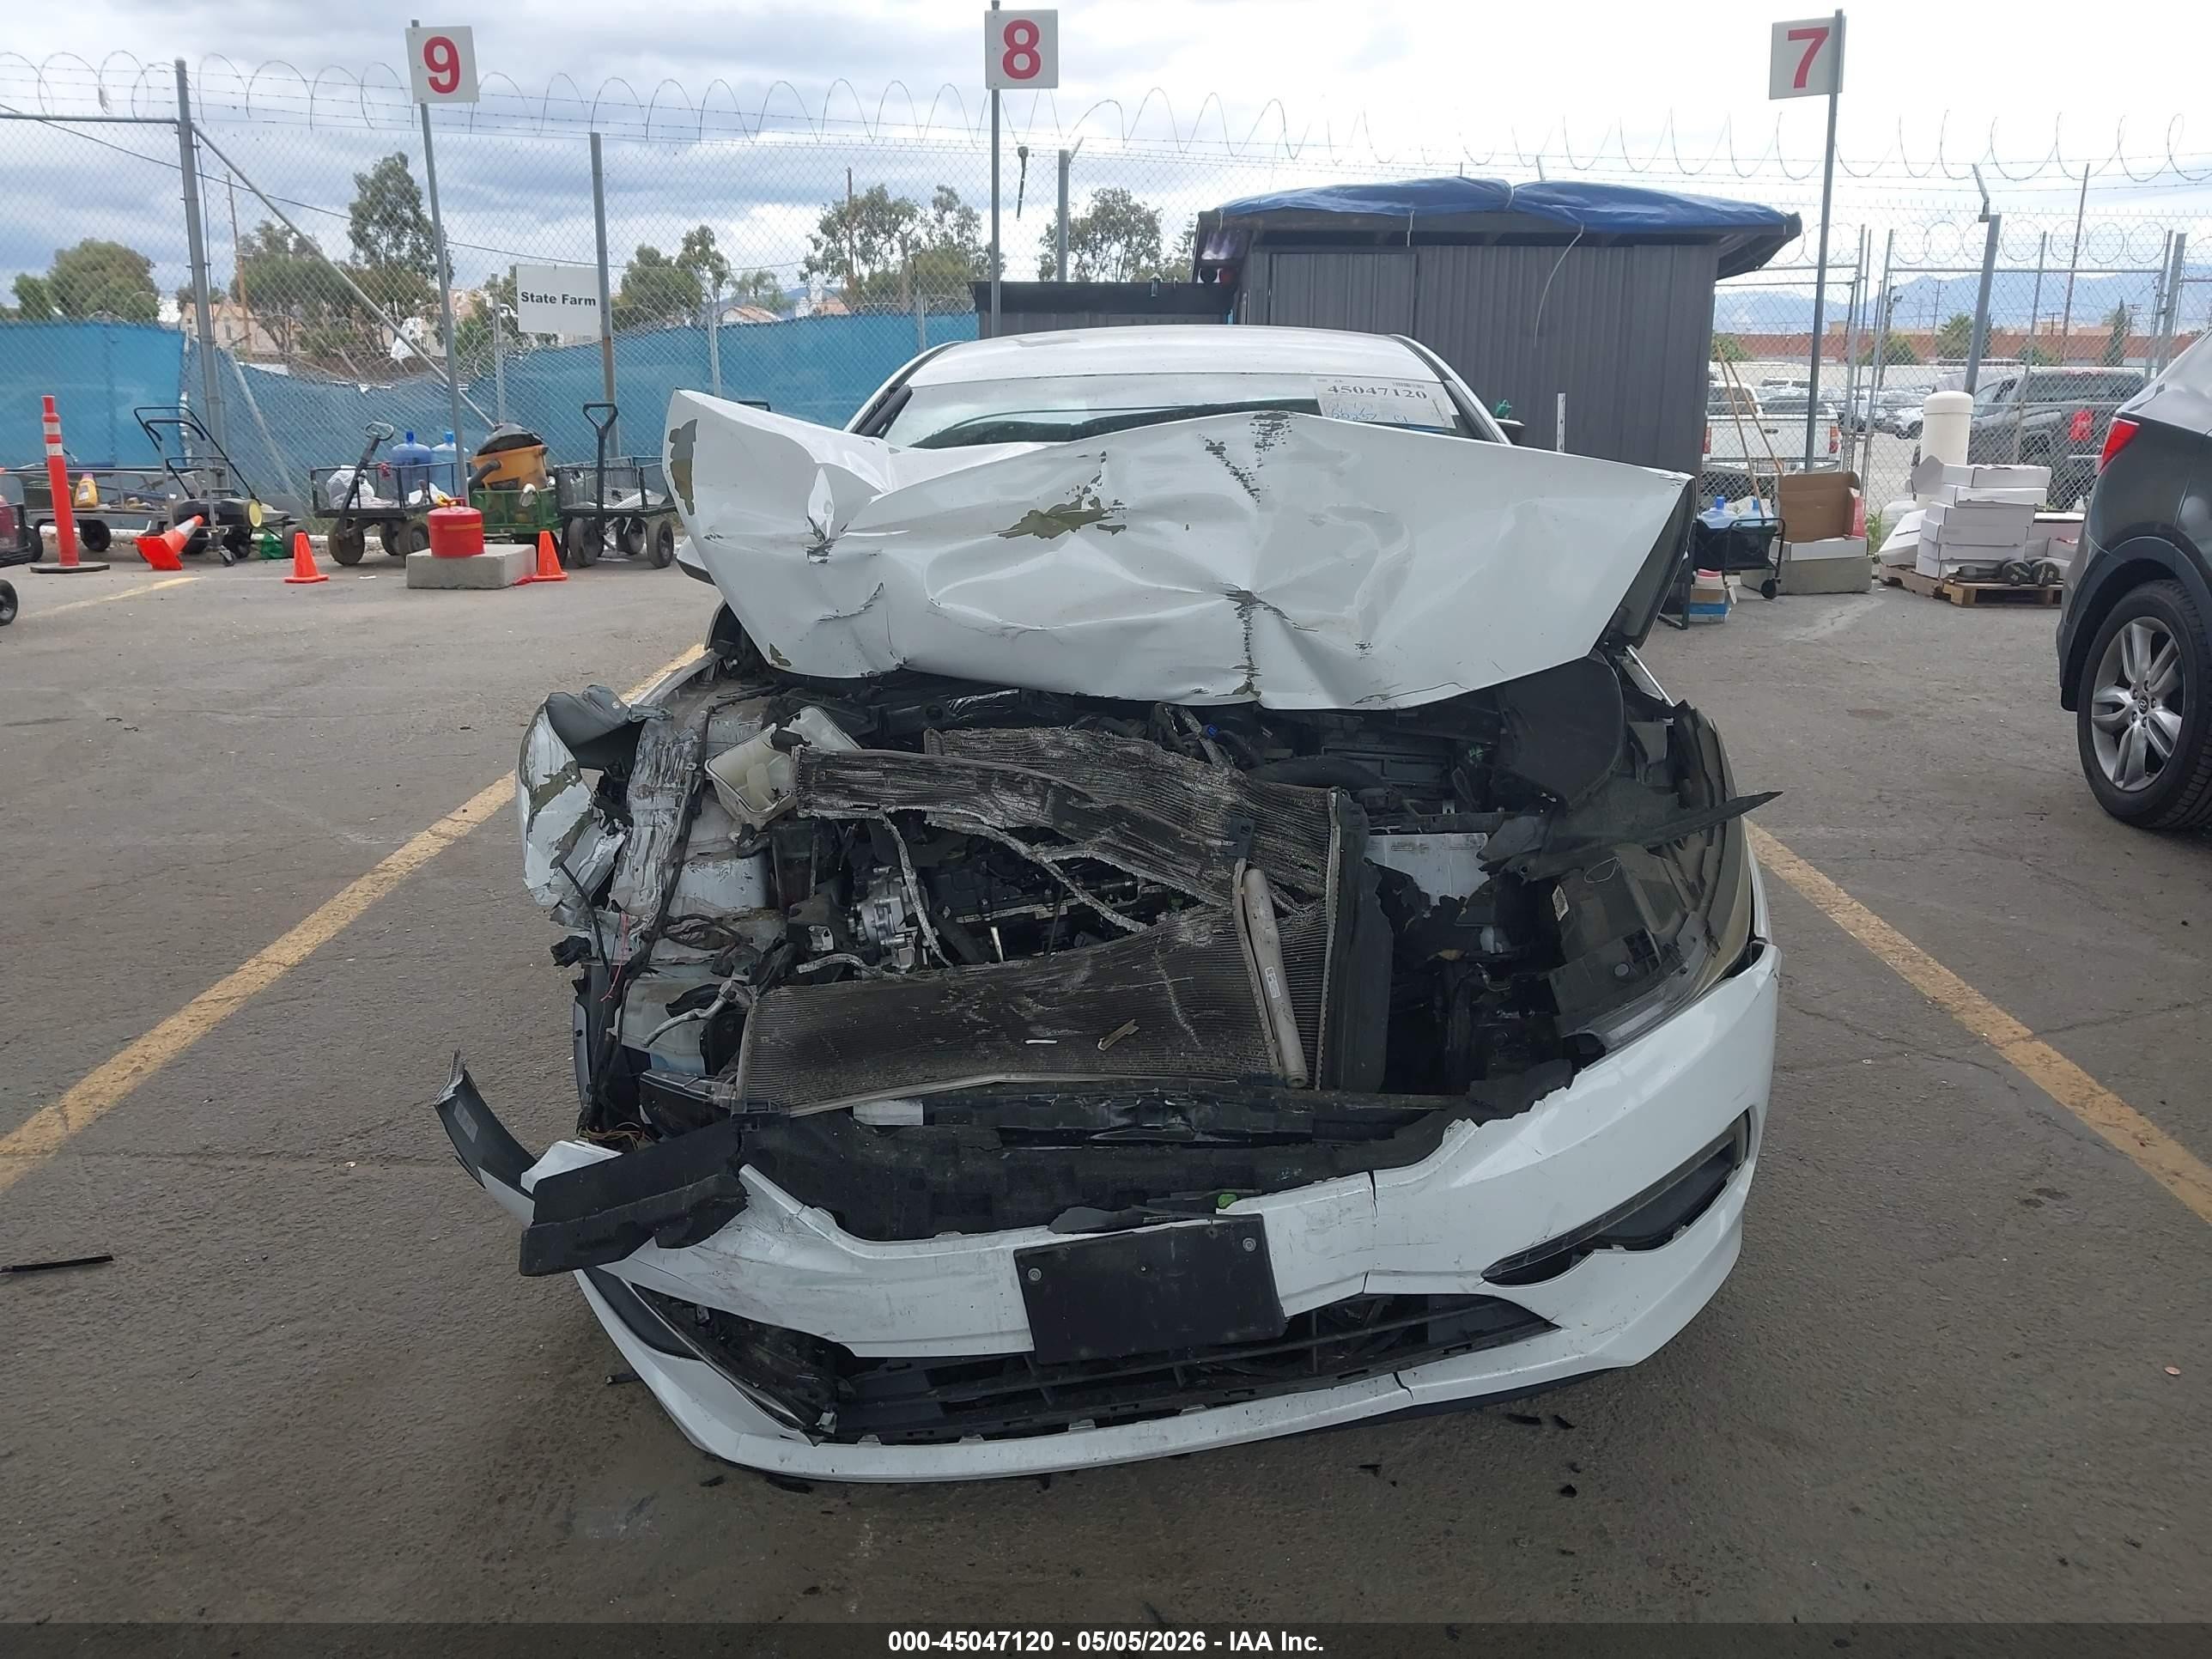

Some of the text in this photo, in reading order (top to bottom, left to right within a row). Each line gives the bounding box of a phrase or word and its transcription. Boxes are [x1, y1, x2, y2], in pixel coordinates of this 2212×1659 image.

[422, 35, 460, 94] 9
[1002, 19, 1042, 80] 8
[1787, 27, 1830, 89] 7
[520, 291, 597, 307] State Farm
[1328, 385, 1427, 398] 45047120
